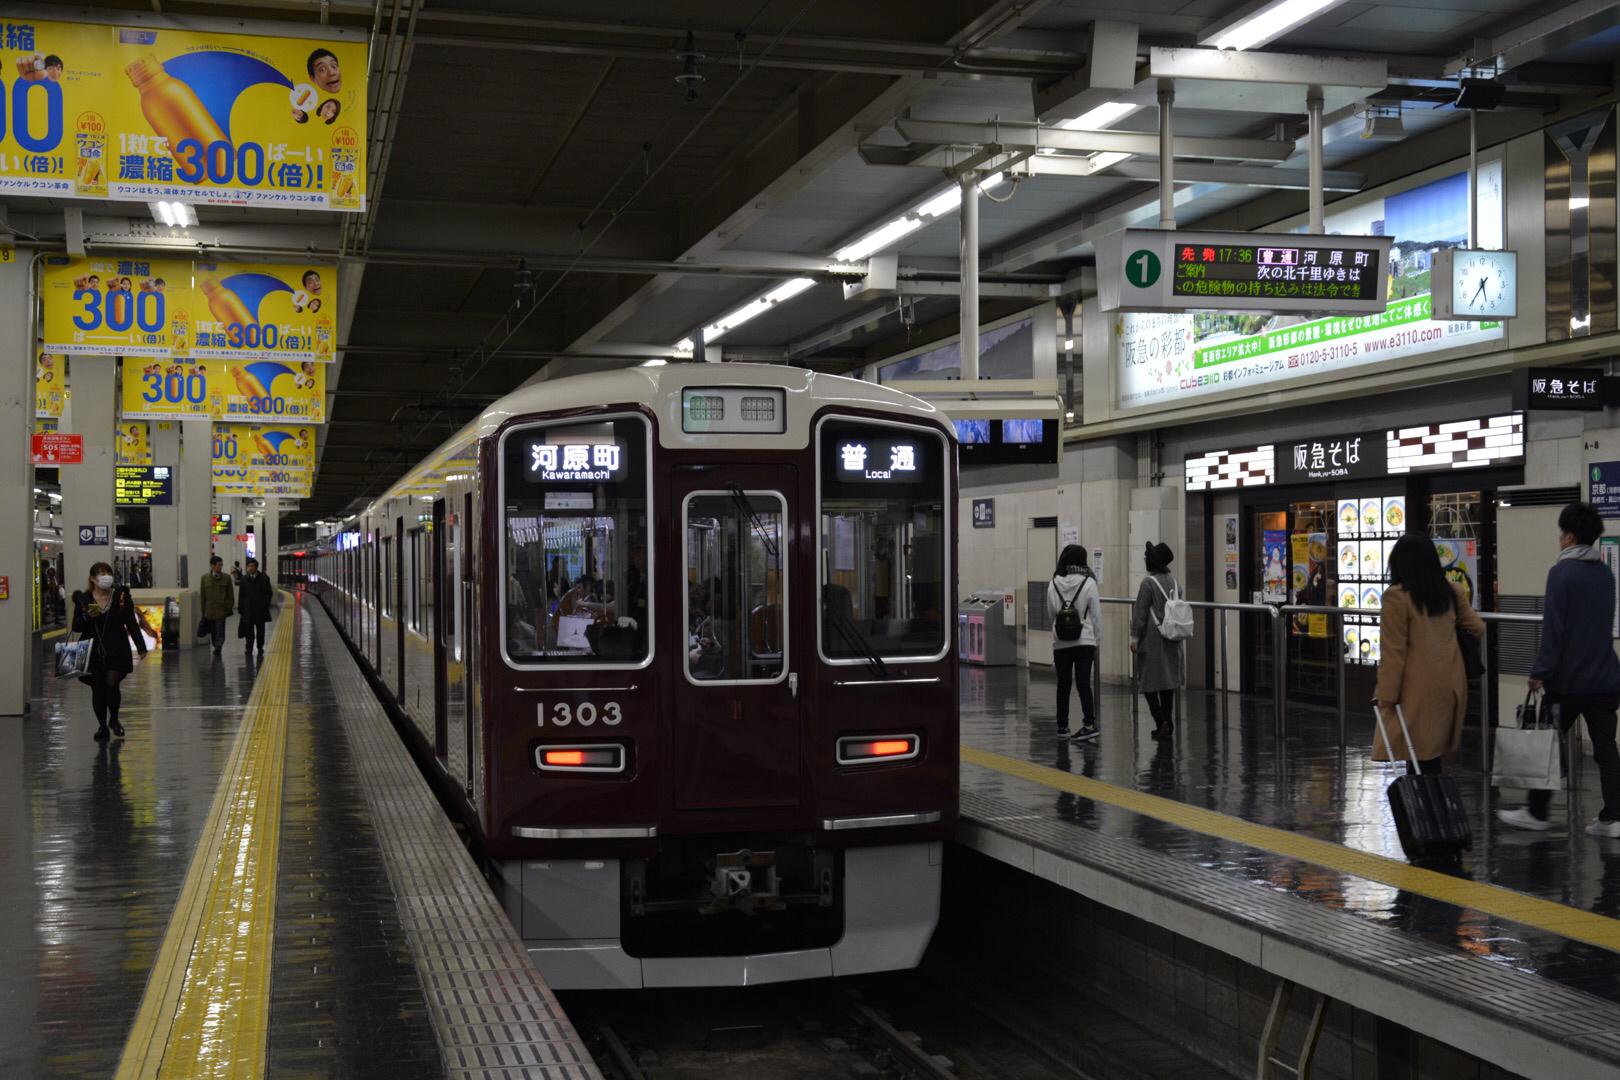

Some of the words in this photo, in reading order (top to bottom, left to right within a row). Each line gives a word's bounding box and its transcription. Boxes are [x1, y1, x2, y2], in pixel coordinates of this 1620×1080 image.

[0, 24, 35, 51] 縮
[1136, 255, 1150, 283] 1
[1181, 247, 1216, 263] 先発
[1219, 248, 1253, 264] 17:36
[1303, 250, 1370, 268] 河原町
[1256, 266, 1362, 283] 次の北千里ゆきは
[72, 288, 166, 333] 300
[1300, 342, 1359, 367] 0120-5-3110-5
[1364, 326, 1443, 354] www.e3110.com
[142, 373, 207, 404] 300
[1532, 378, 1598, 395] 阪急そば
[531, 444, 621, 471] 河原町
[1293, 437, 1361, 471] 阪急そば
[542, 470, 611, 480] Kawaramachi
[865, 470, 892, 479] Local
[536, 701, 623, 727] 1303
